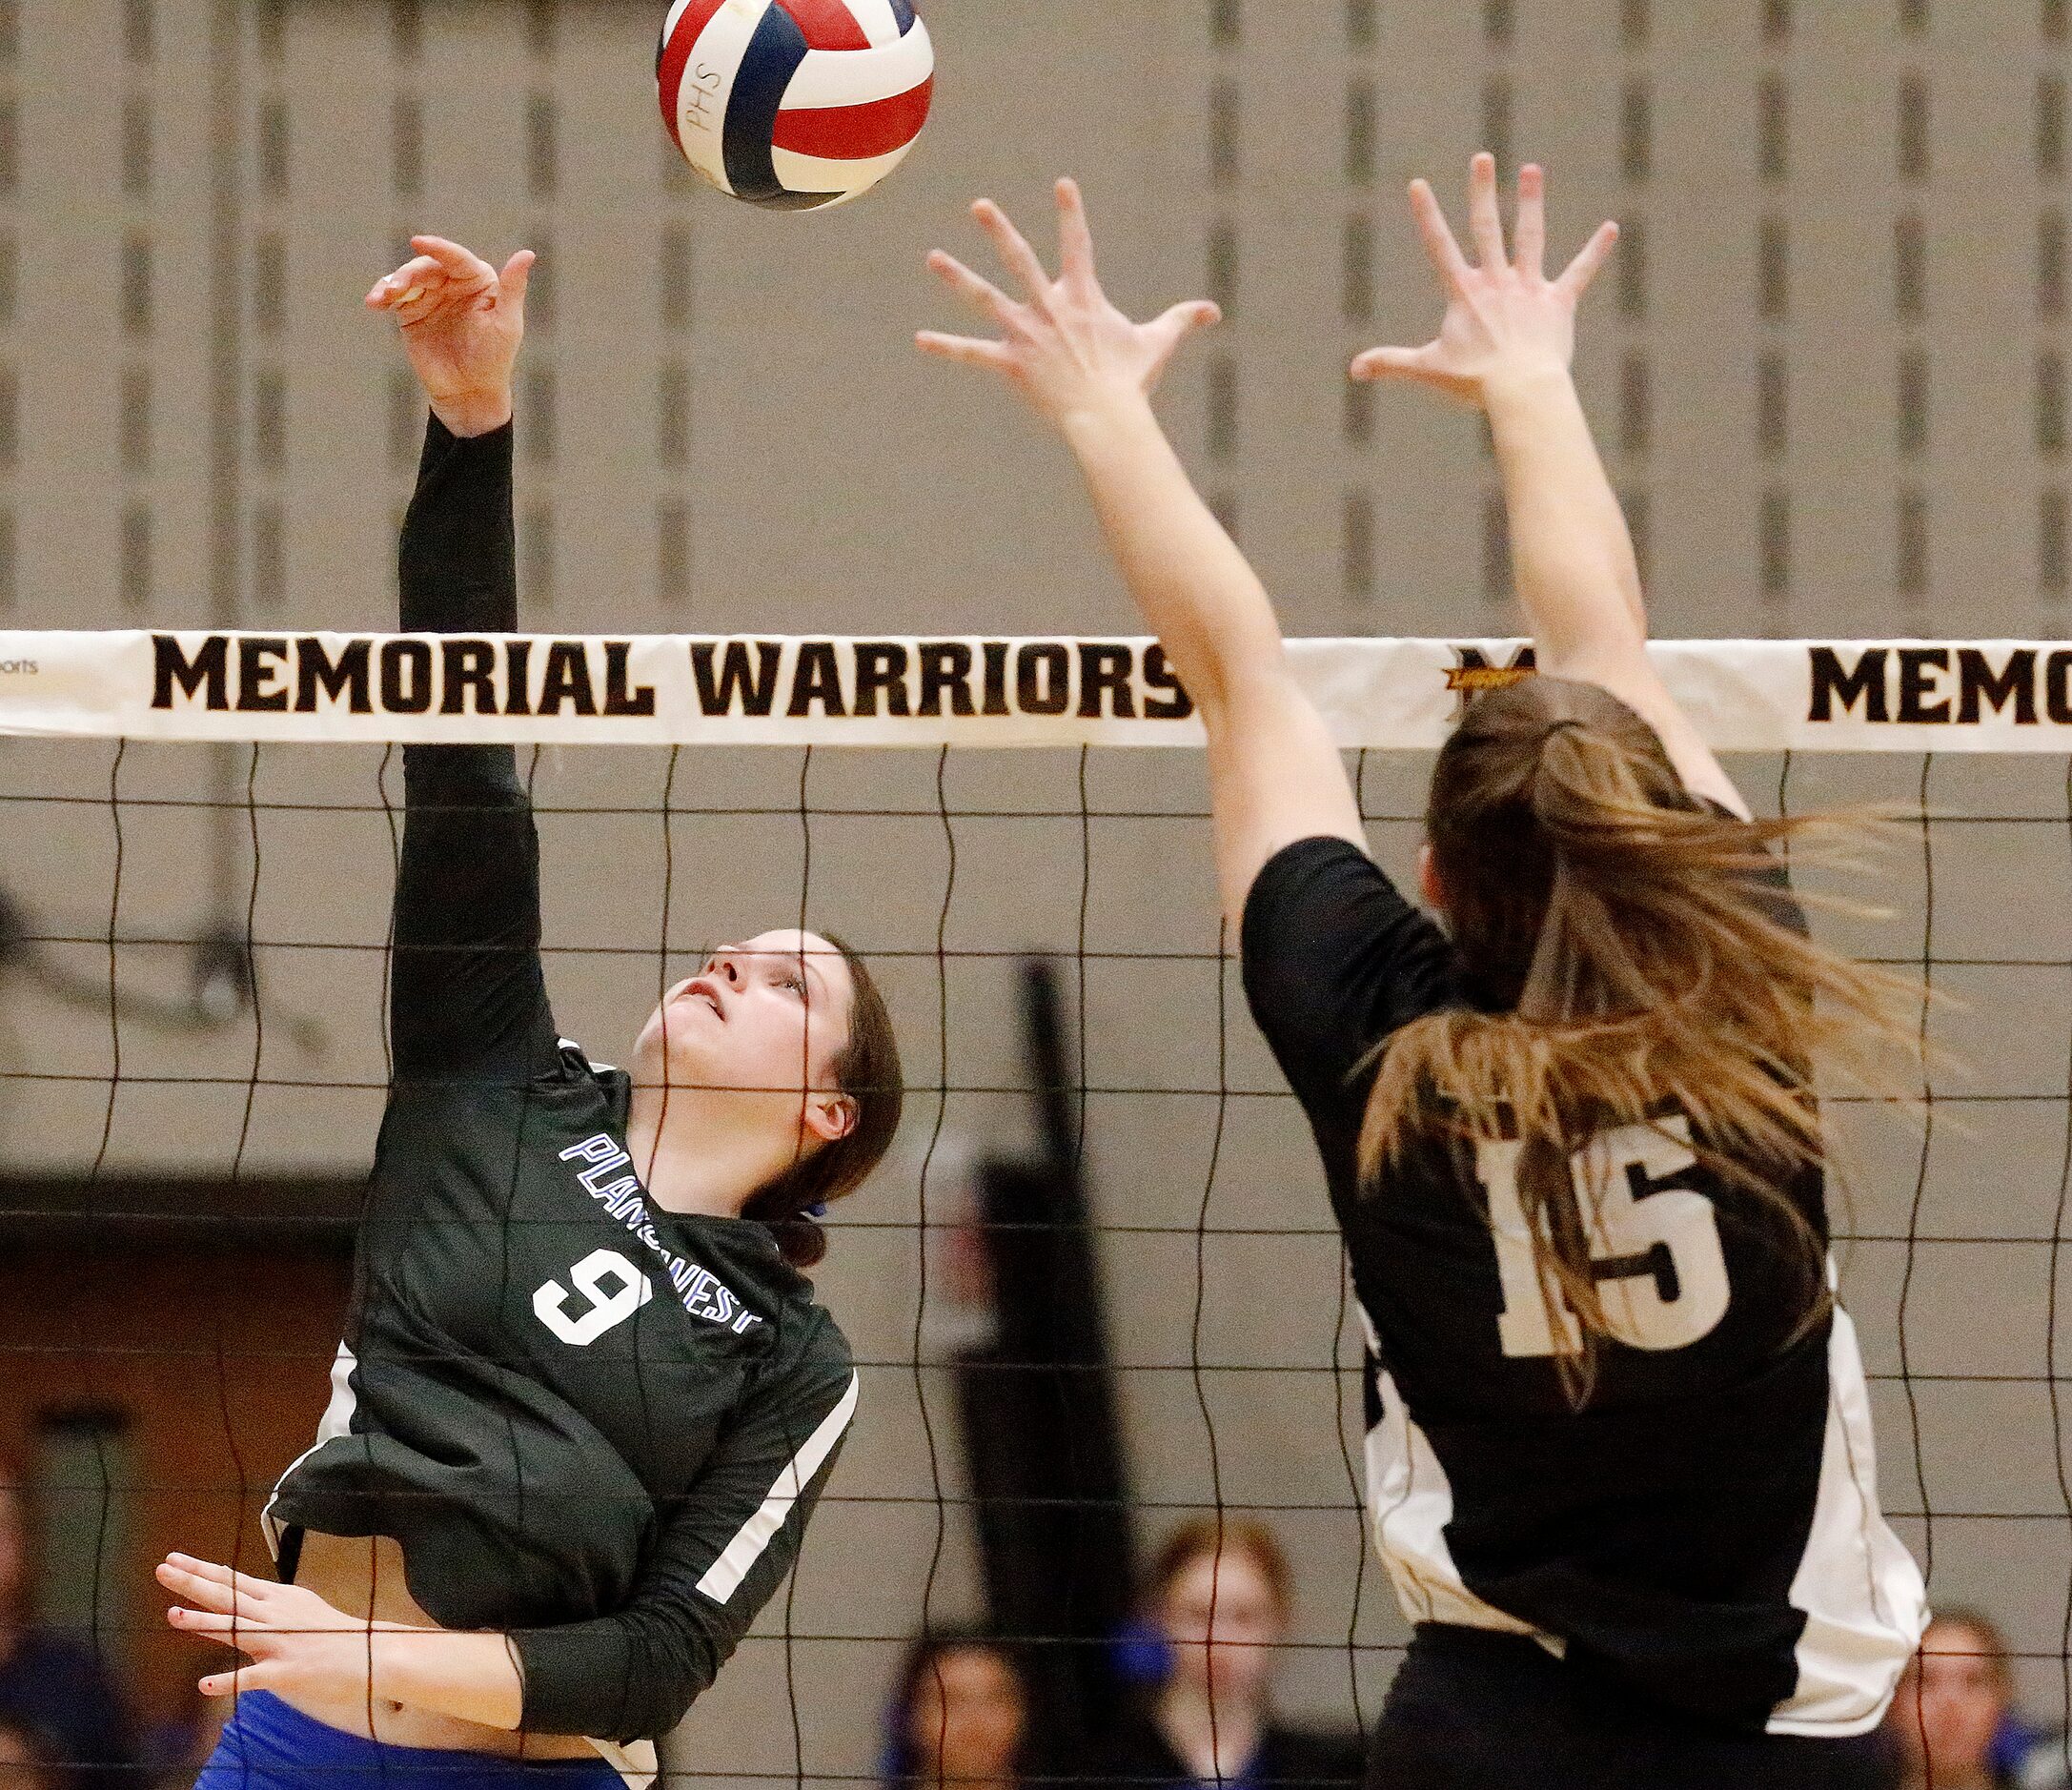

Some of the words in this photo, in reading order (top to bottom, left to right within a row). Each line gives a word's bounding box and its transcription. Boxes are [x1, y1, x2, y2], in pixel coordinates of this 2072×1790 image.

[685, 62, 721, 132] PHS
[0, 659, 39, 676] orts
[150, 634, 656, 717] MEMORIAL
[689, 641, 1195, 720] WARRIORS
[1476, 1113, 1731, 1358] 15
[532, 1248, 653, 1346] 9
